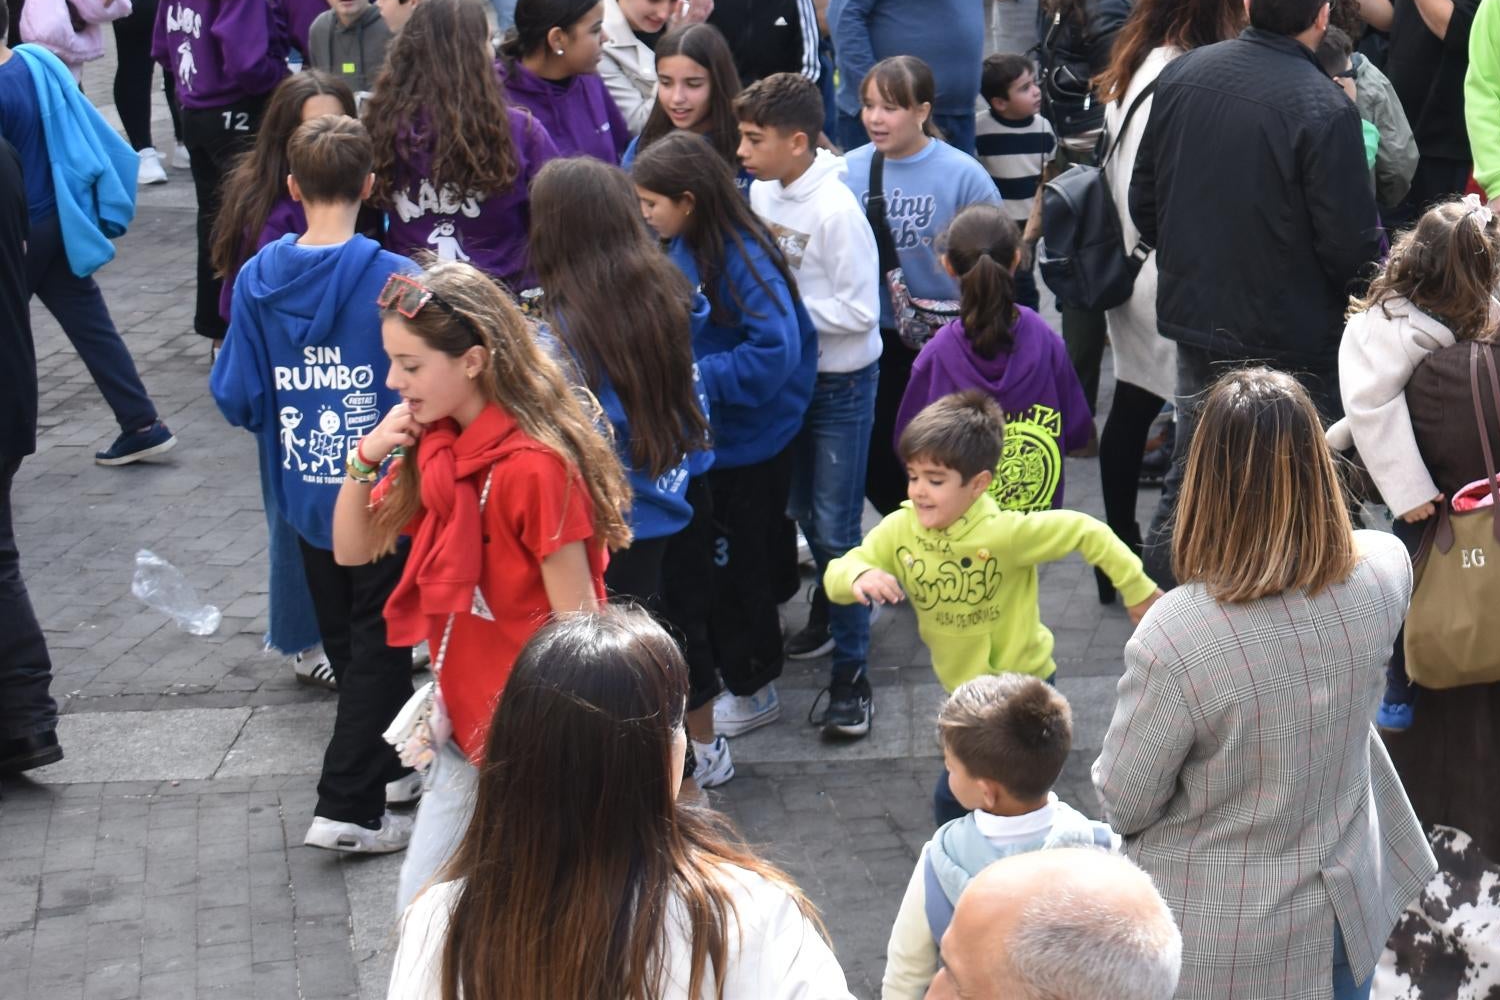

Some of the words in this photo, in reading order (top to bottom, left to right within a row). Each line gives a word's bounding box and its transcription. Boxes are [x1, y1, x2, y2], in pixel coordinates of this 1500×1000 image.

[222, 111, 250, 131] 12
[303, 346, 342, 365] SIN
[274, 365, 374, 391] RUMBO
[714, 537, 729, 567] 3
[1461, 548, 1485, 568] EG
